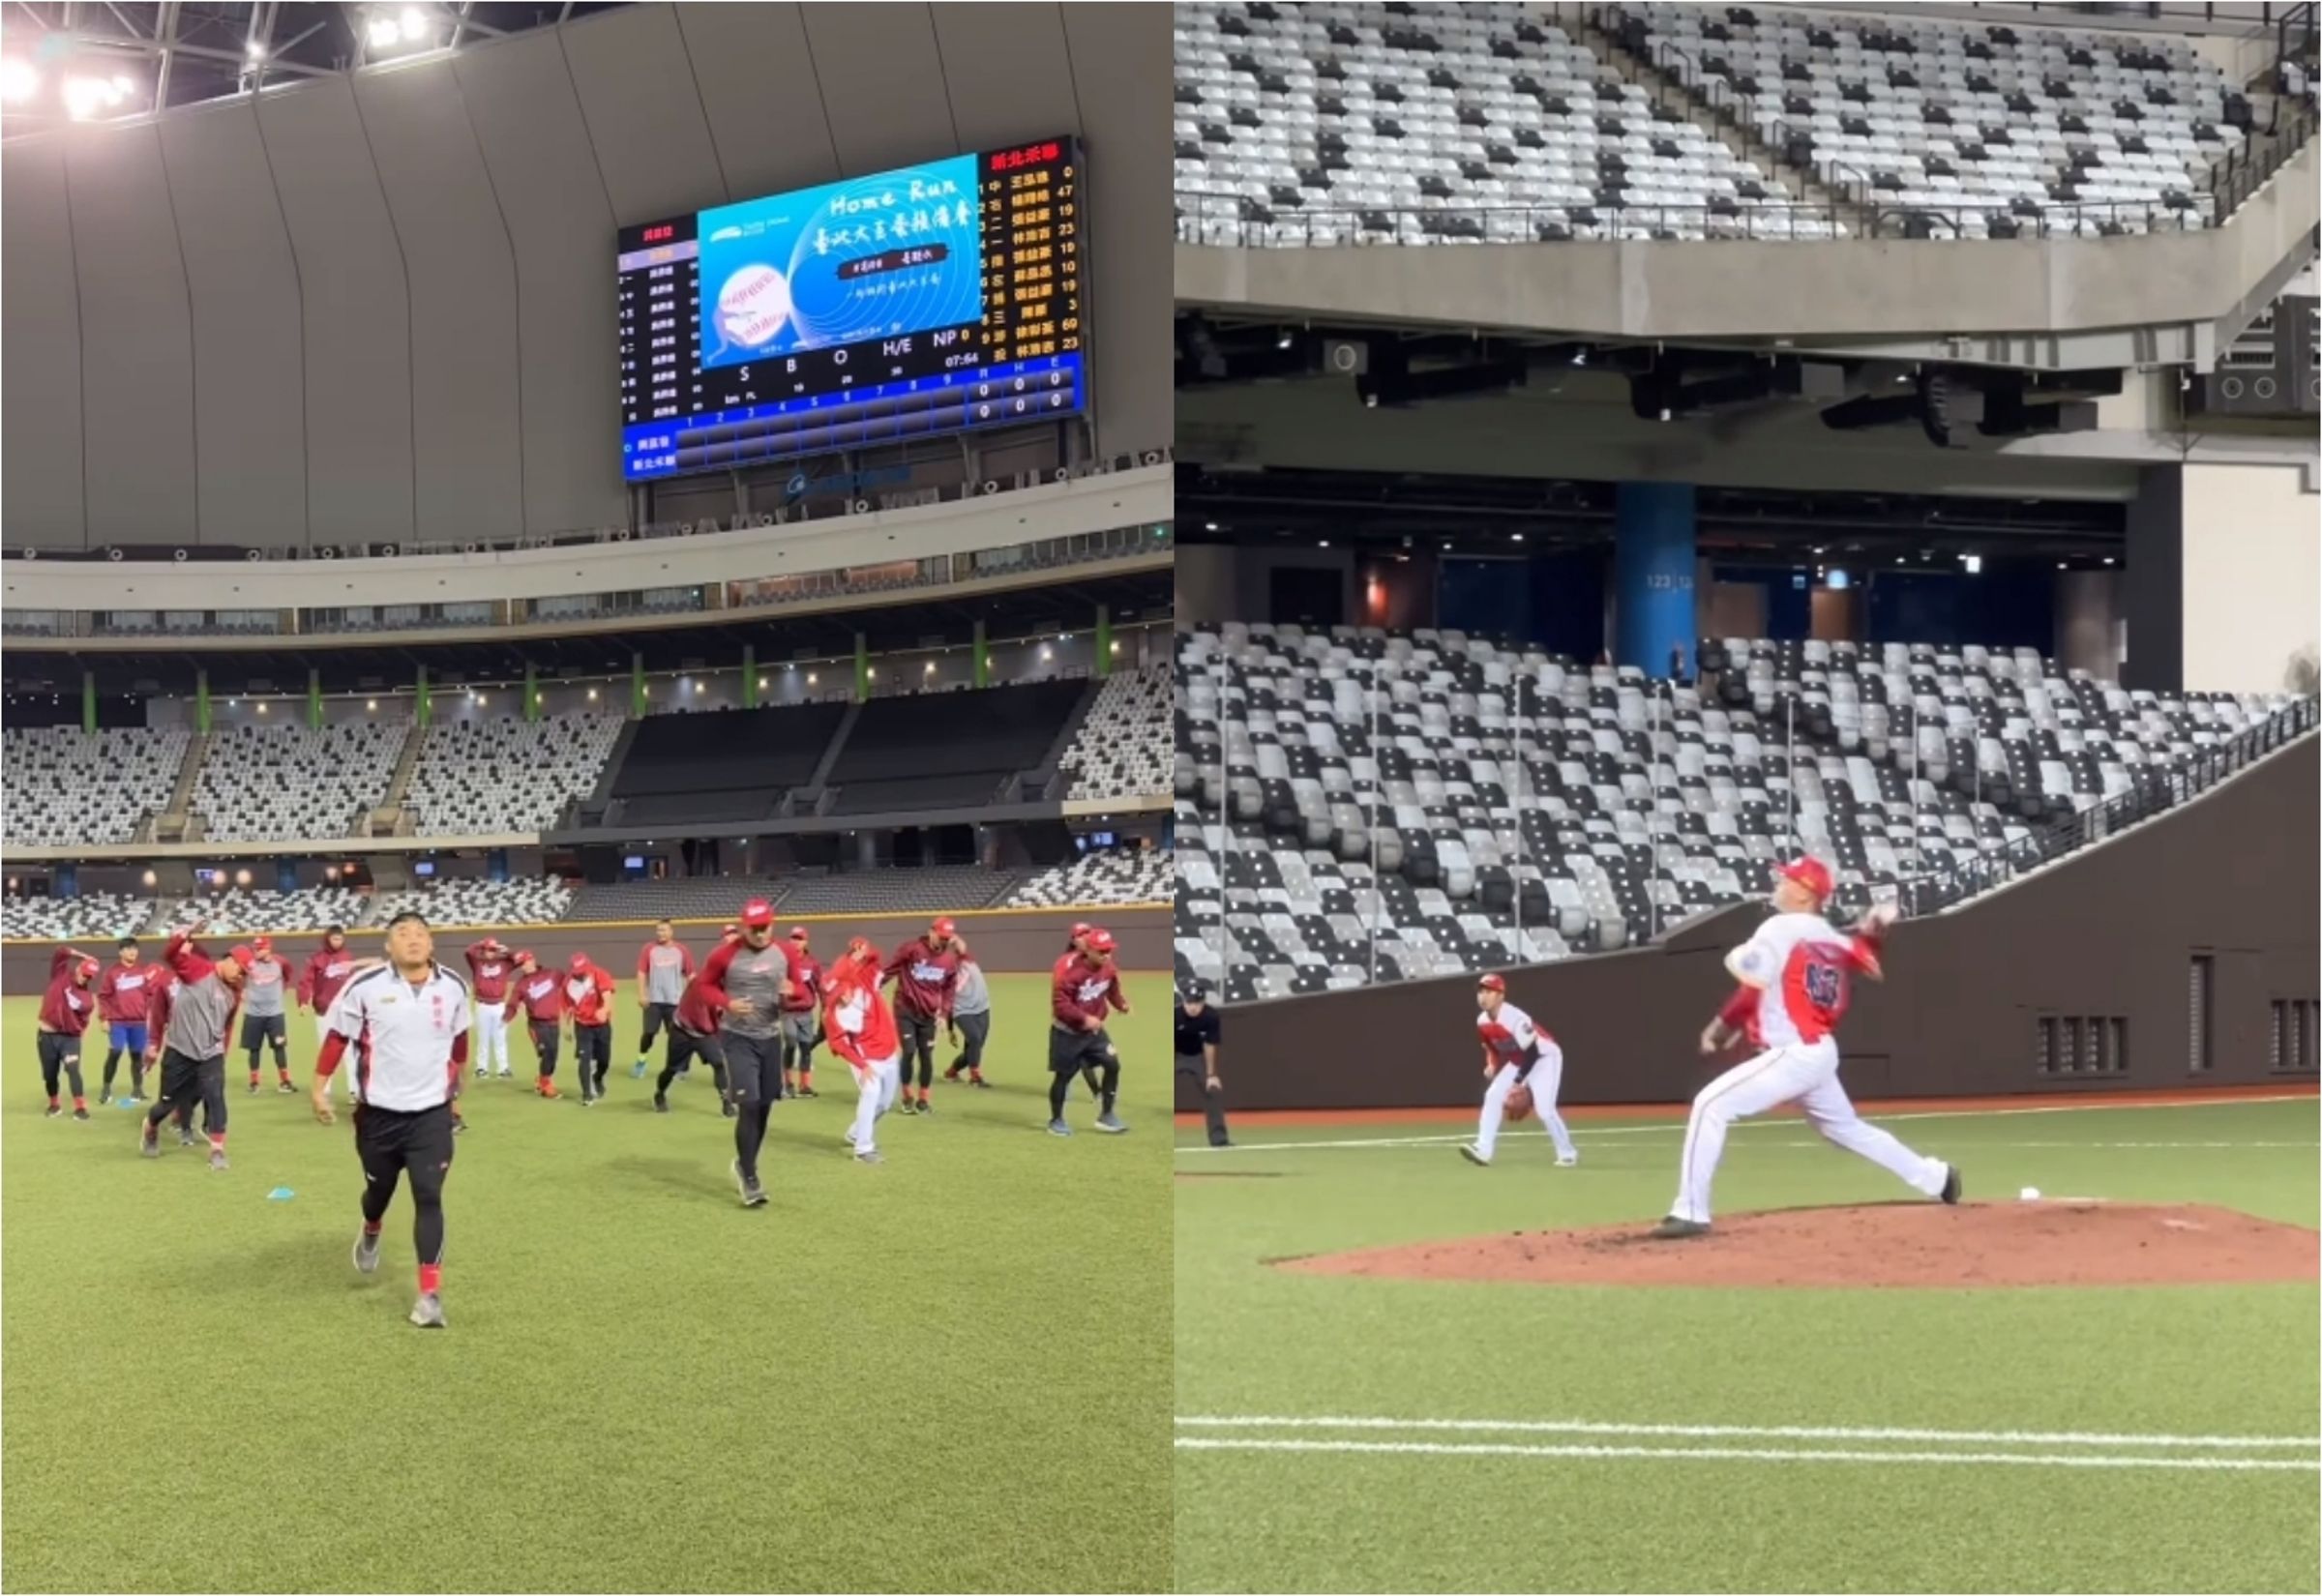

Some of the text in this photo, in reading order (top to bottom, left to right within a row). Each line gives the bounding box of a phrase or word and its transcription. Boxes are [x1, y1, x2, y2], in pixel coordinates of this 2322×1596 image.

[830, 179, 957, 217] Home Run
[883, 338, 912, 356] H/E
[934, 330, 958, 348] NP
[740, 367, 750, 382] S
[787, 359, 797, 374] B
